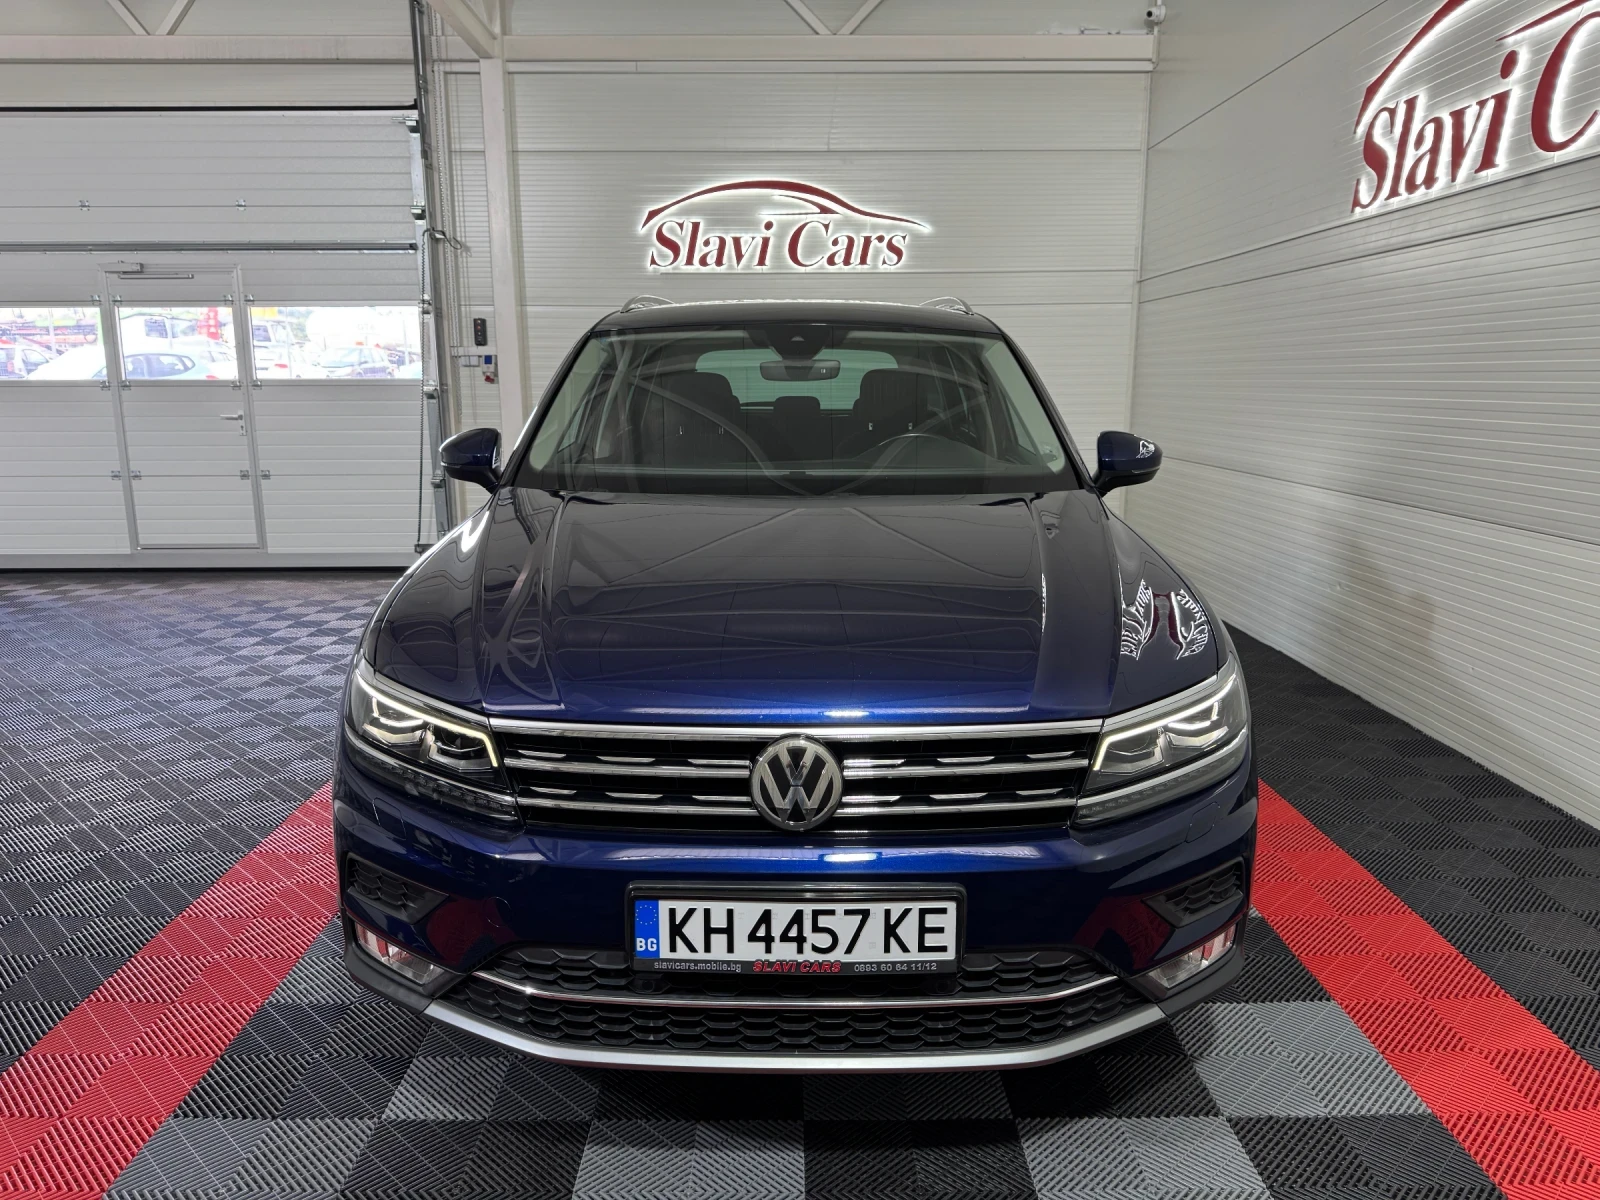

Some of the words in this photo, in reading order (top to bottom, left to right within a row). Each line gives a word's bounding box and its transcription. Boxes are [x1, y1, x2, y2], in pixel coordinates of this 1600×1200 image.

[1350, 49, 1520, 214] Slavi
[649, 219, 774, 268] Slavi
[787, 219, 908, 268] Cars
[668, 906, 734, 954] KH
[747, 908, 871, 955] 4457
[883, 906, 949, 954] KE
[636, 937, 657, 952] BG
[654, 961, 742, 973] slavicars.mobile.bg
[752, 960, 797, 973] SLAVI
[800, 960, 842, 973] CARS
[853, 963, 878, 972] 0893
[880, 963, 893, 972] 60
[910, 962, 937, 971] 11/12
